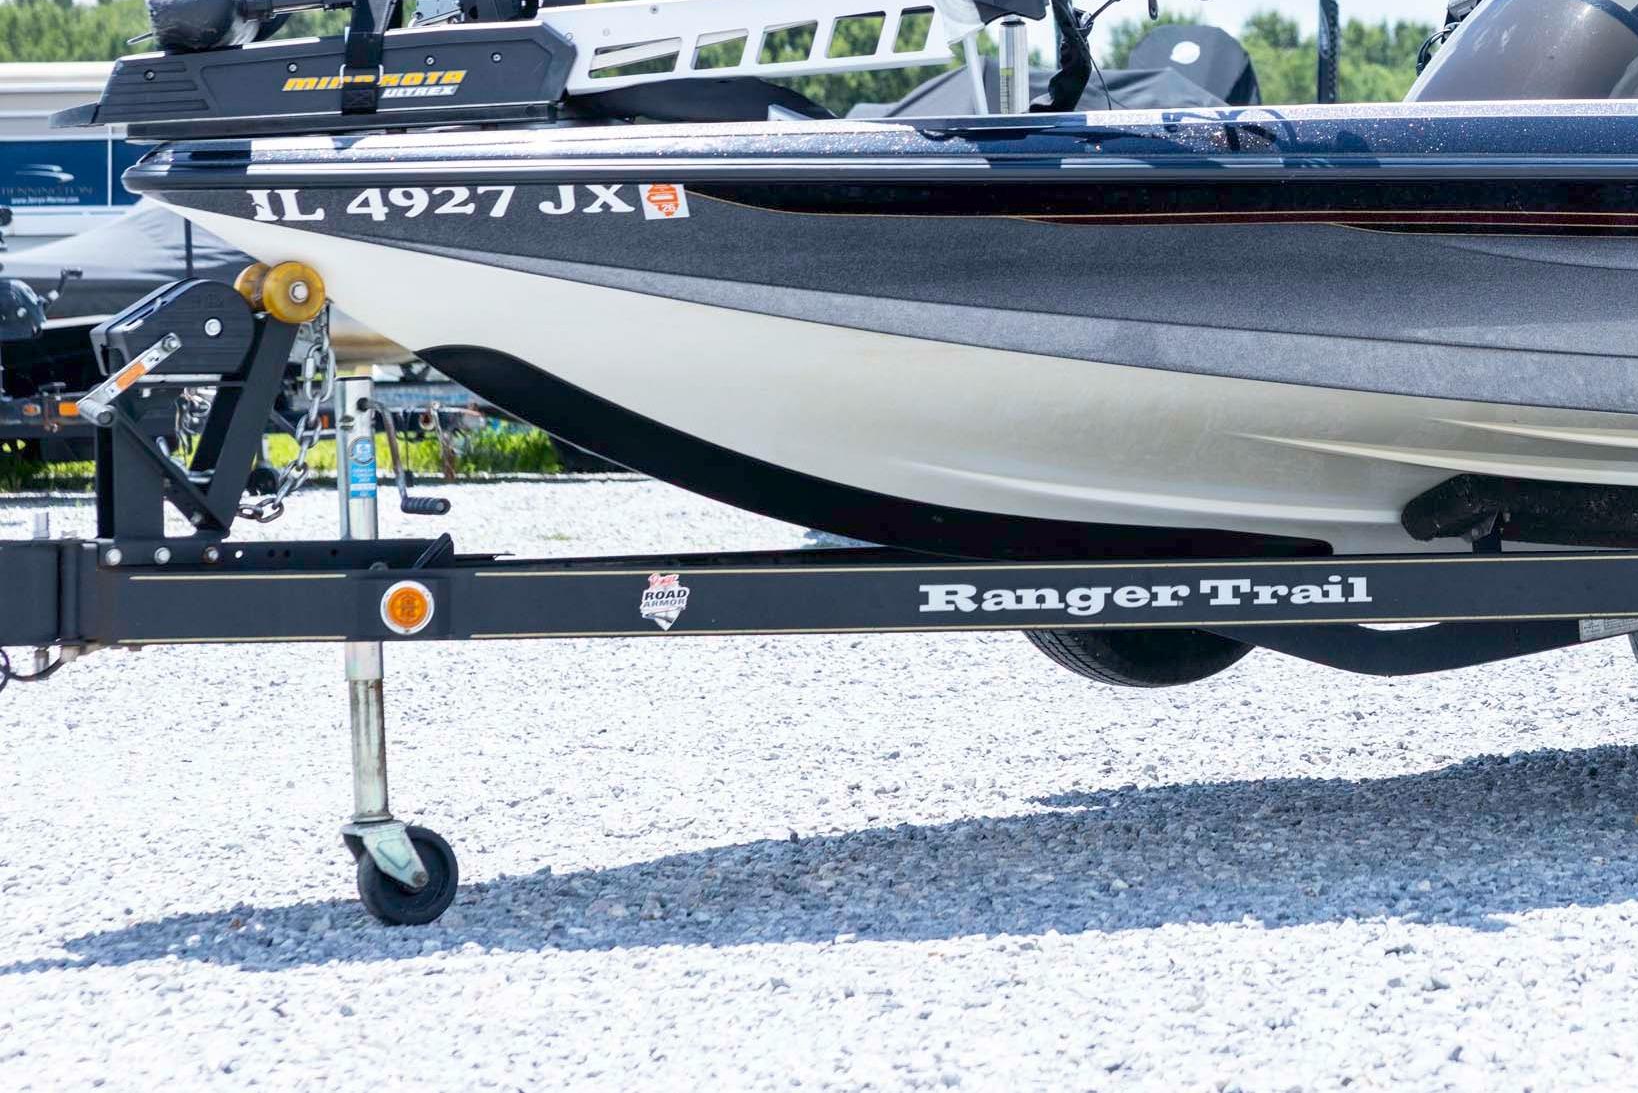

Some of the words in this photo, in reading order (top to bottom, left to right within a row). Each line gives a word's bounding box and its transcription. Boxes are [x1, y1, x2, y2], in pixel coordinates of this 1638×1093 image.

[381, 84, 459, 99] ULTREX
[246, 189, 325, 221] IL
[346, 186, 516, 221] 4927
[538, 185, 635, 215] JX
[645, 589, 687, 600] ROAD
[919, 584, 1190, 616] Ranger
[1200, 575, 1372, 606] Trail
[643, 598, 685, 608] ARMOR
